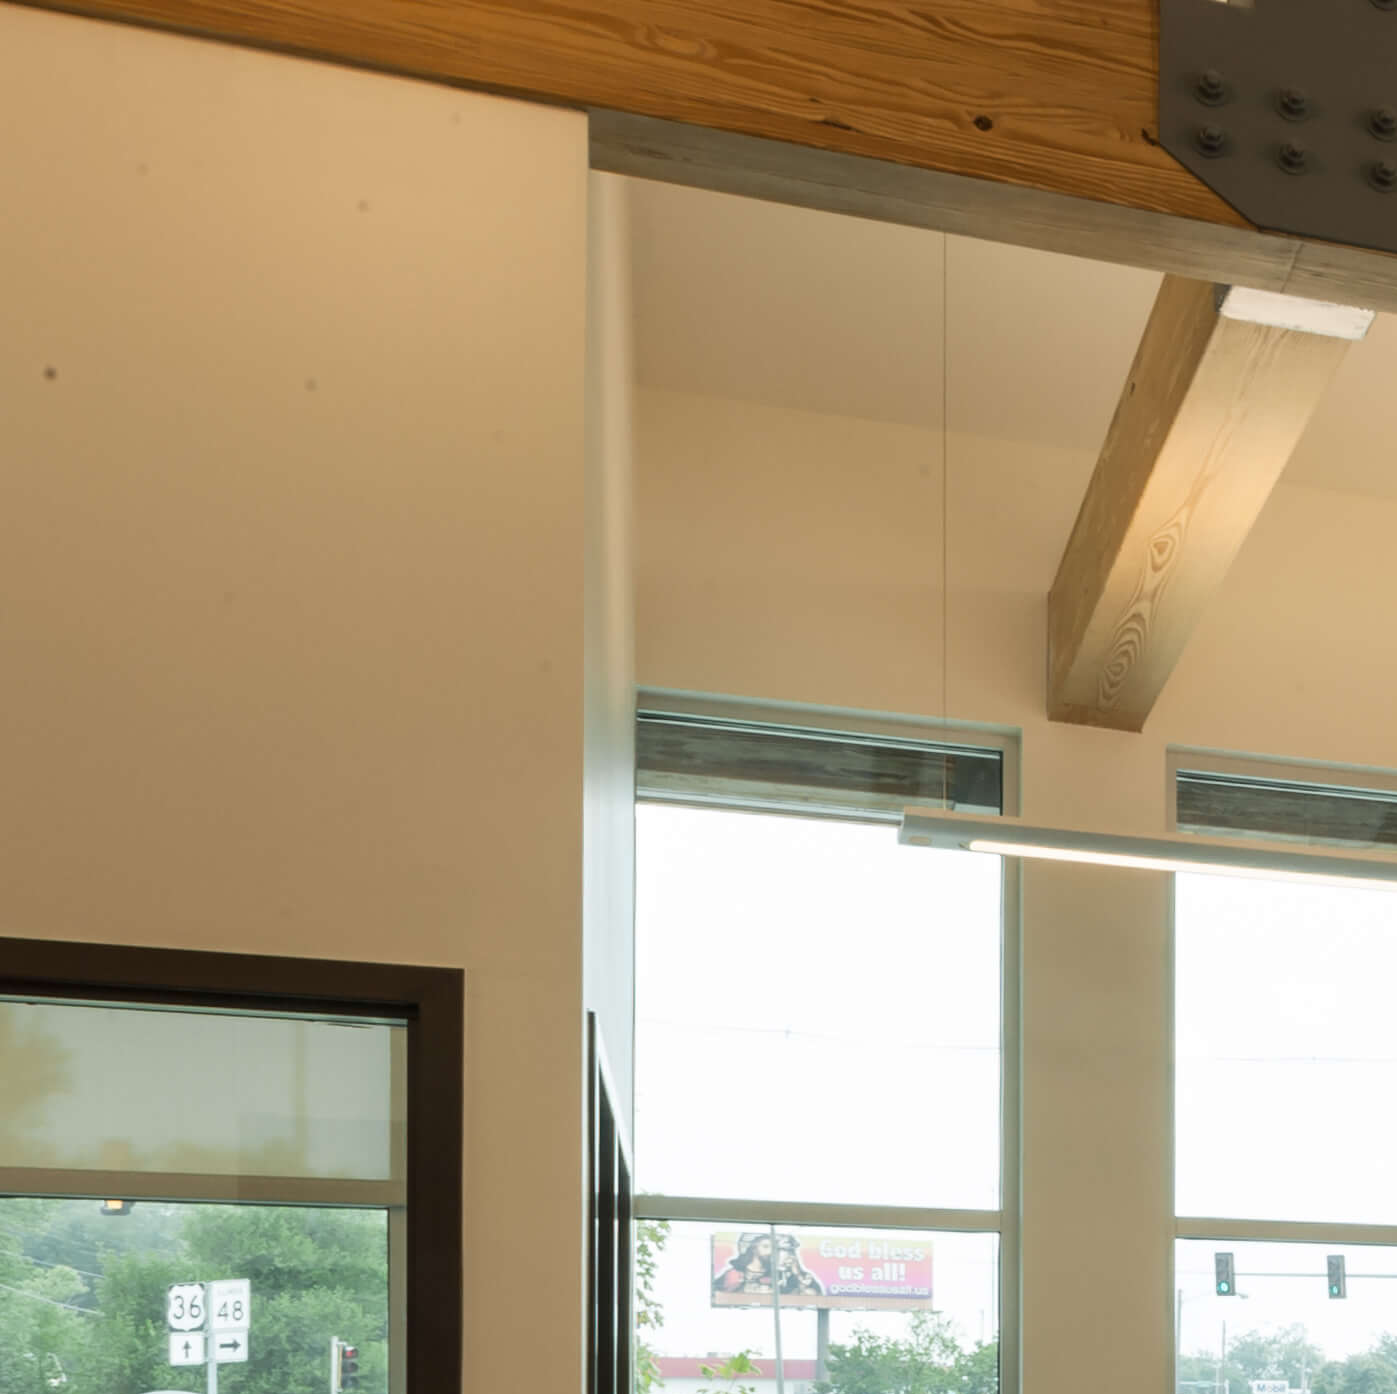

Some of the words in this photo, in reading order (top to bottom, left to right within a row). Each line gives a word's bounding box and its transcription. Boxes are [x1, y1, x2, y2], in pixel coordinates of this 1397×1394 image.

[819, 1239, 862, 1259] God
[868, 1240, 926, 1261] bless
[838, 1266, 864, 1281] us
[871, 1262, 906, 1281] all!
[173, 1295, 202, 1319] 36
[217, 1300, 244, 1321] 48
[1256, 1384, 1285, 1393] Mobil
